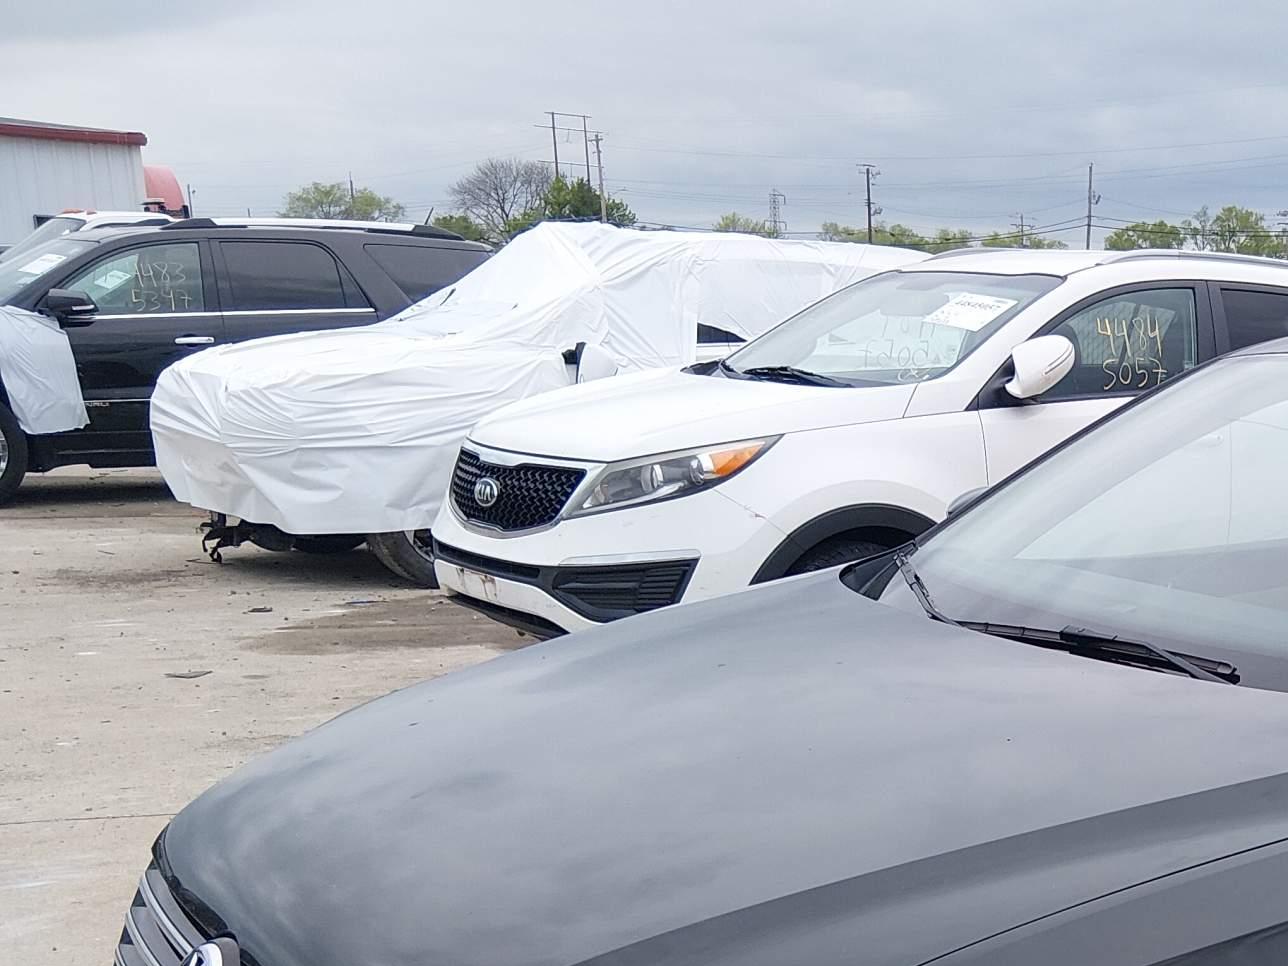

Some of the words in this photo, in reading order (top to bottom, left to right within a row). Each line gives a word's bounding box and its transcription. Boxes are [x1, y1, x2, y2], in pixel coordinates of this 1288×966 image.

[131, 288, 192, 312] 5347
[1096, 313, 1162, 357] 4484
[1102, 356, 1168, 391] 5057
